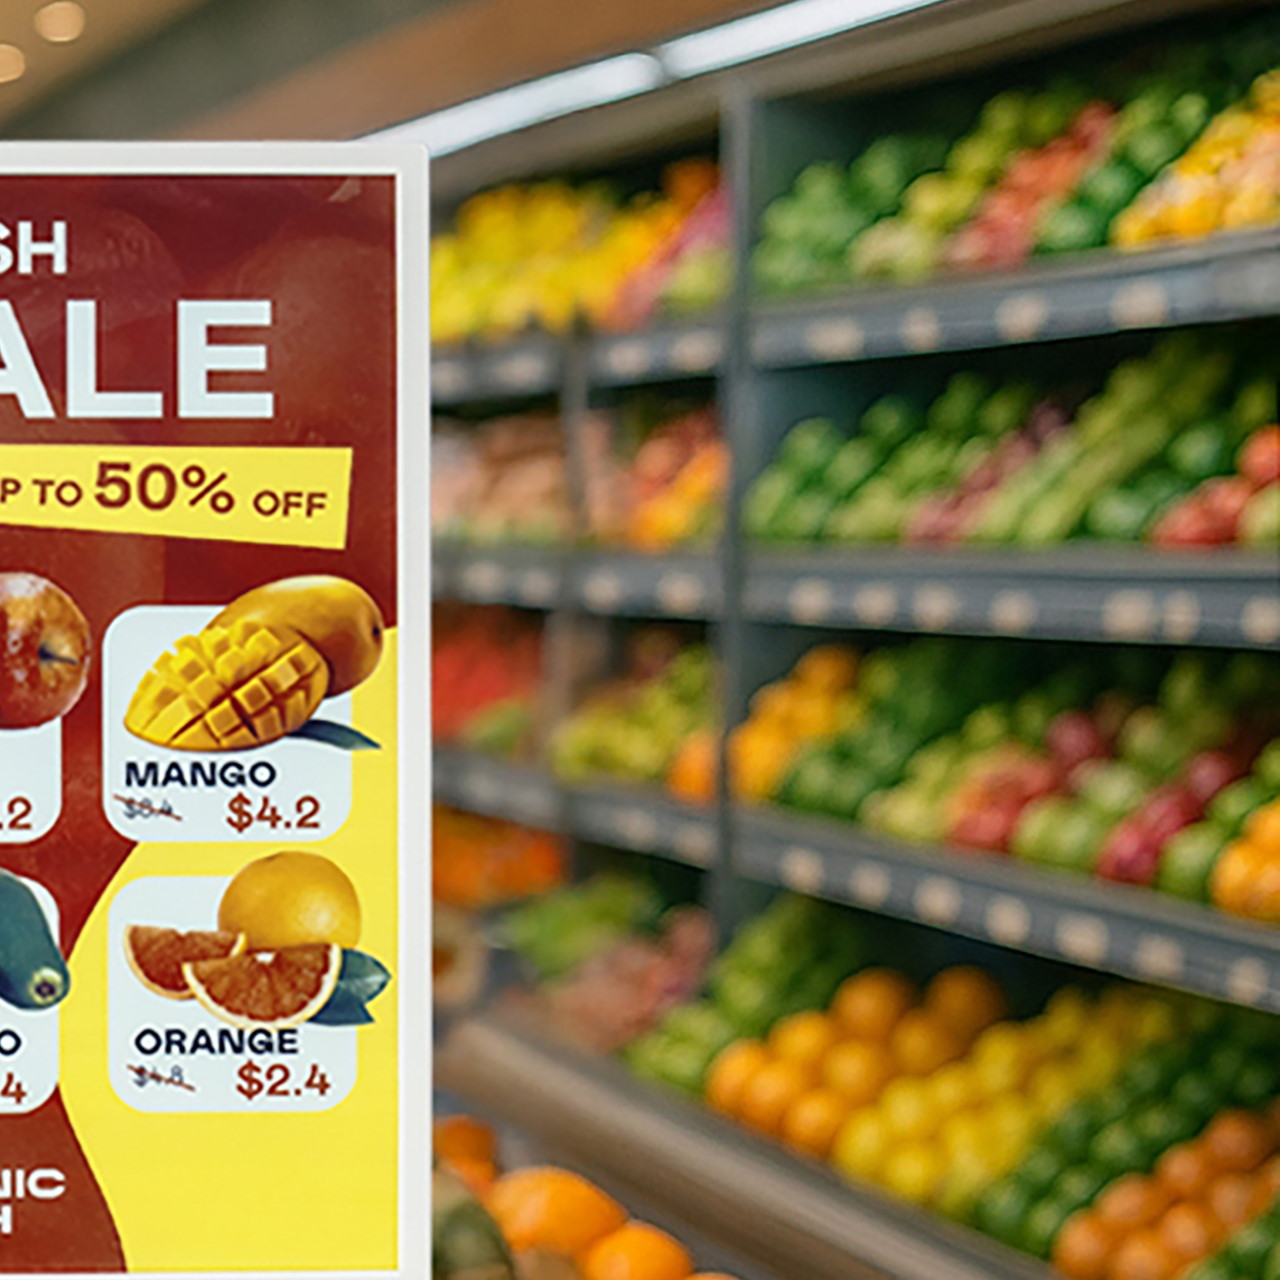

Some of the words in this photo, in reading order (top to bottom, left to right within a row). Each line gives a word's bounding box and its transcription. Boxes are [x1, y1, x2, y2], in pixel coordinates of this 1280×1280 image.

[33, 479, 82, 507] TO
[94, 461, 235, 514] 50%
[253, 490, 327, 518] OFF
[125, 761, 276, 787] MANGO
[226, 793, 320, 832] $4.2
[134, 1028, 298, 1055] ORANGE
[236, 1060, 330, 1100] $2.4
